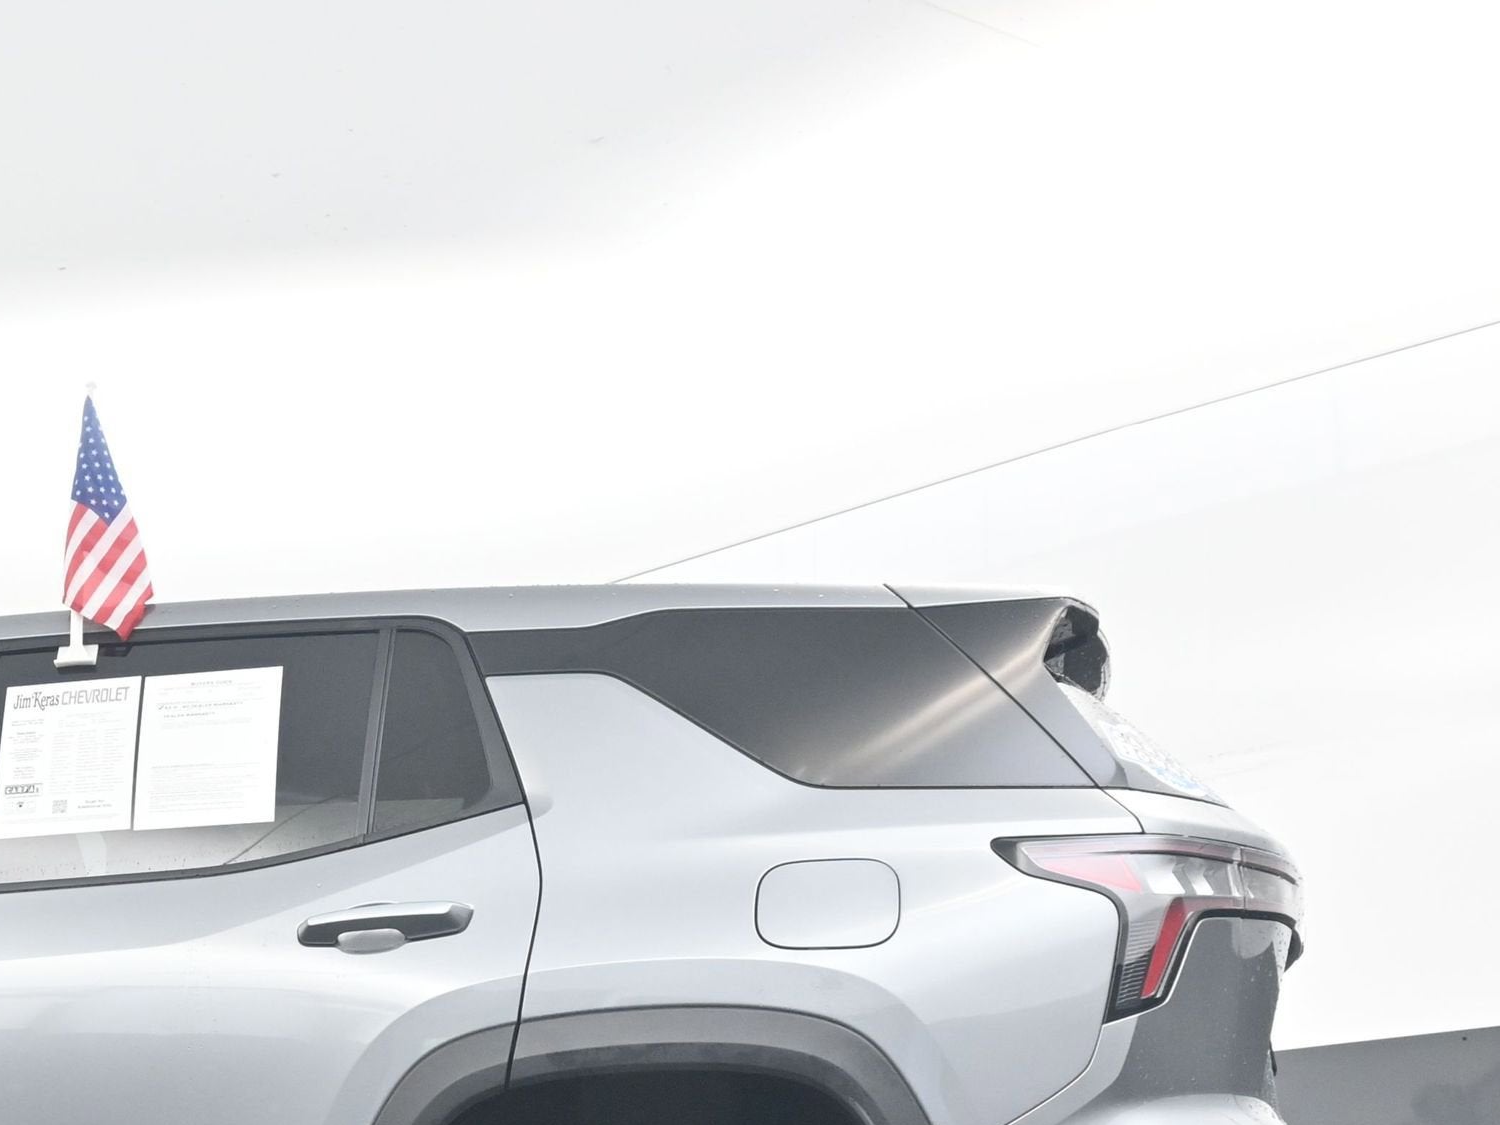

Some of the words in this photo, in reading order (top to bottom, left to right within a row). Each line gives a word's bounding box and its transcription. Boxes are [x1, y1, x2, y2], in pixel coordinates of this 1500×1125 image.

[13, 694, 32, 709] Jim
[32, 692, 60, 711] Keras
[61, 686, 130, 705] CHEVROLET
